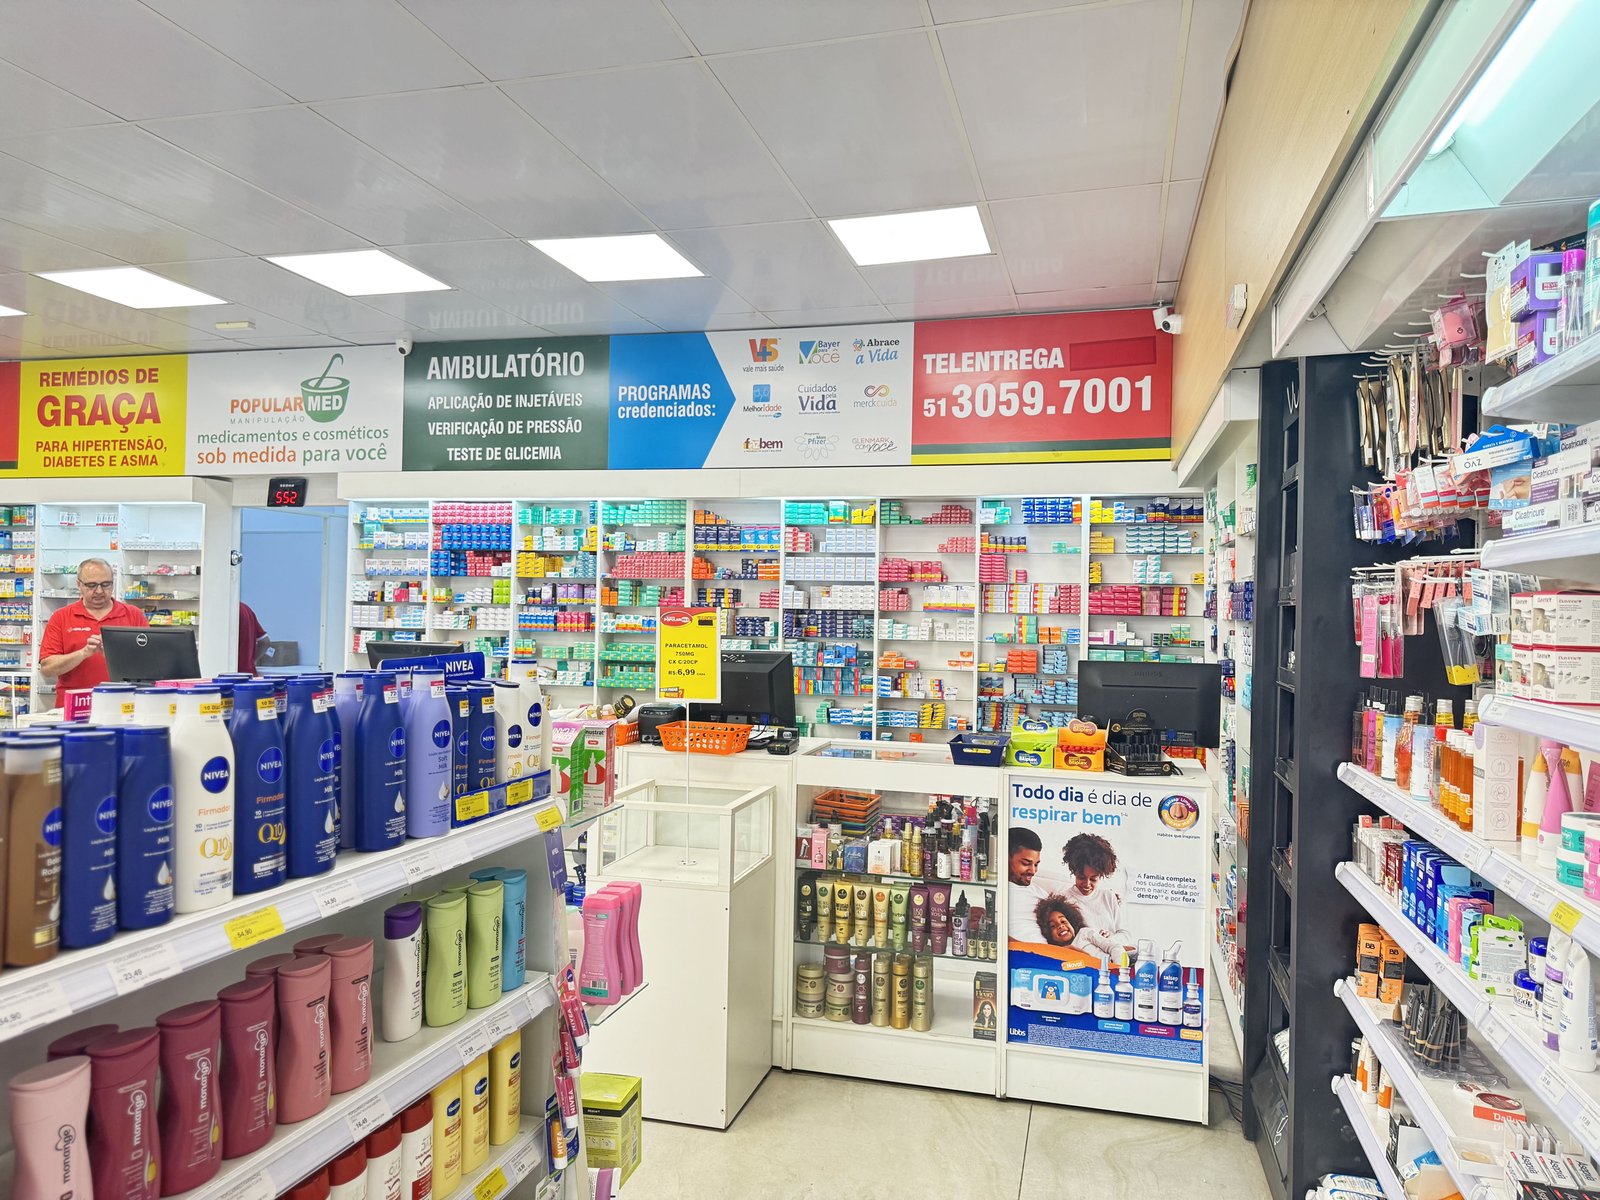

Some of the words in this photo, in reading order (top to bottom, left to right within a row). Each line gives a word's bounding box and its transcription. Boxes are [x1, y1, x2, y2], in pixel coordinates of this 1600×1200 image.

[818, 340, 840, 348] Bayer
[867, 339, 900, 347] Abrace
[426, 347, 585, 379] AMBULATÓRIO
[855, 354, 865, 364] a
[868, 348, 898, 363] Vida
[923, 347, 1065, 374] TELENTREGA
[39, 366, 129, 387] REMÉDIOS
[135, 368, 159, 384] DE
[743, 365, 753, 373] vale
[754, 364, 767, 372] mais
[768, 363, 784, 372] saúde
[618, 383, 711, 402] PROGRAMAS
[798, 384, 837, 393] Cuidados
[923, 398, 947, 417] 51
[951, 375, 1152, 419] 3059.7001
[230, 396, 303, 414] POPULAR
[307, 394, 343, 412] MED
[428, 393, 493, 412] APLICAÇÃO
[497, 395, 511, 408] DE
[515, 391, 583, 408] INJETÁVEIS
[617, 401, 716, 418] credenciados:
[798, 394, 837, 411] Vida
[37, 392, 161, 433] GRAÇA
[230, 415, 306, 425] MANIPULAÇÃO
[197, 429, 297, 444] medicamentos
[302, 432, 310, 441] e
[313, 426, 389, 441] cosméticos
[428, 419, 503, 438] VERIFICAÇÃO
[508, 421, 523, 434] DE
[527, 416, 582, 434] PRESSÃO
[36, 441, 70, 453] PARA
[73, 435, 168, 453] HIPERTENSÃO,
[1560, 438, 1588, 451] Cicatricure
[43, 455, 106, 468] DIABETES
[109, 454, 116, 467] E
[120, 453, 158, 467] ASMA
[197, 447, 227, 464] sob
[233, 445, 297, 463] medida
[302, 449, 341, 466] para
[346, 443, 388, 461] você
[447, 447, 482, 461] TESTE
[486, 447, 502, 460] DE
[505, 446, 561, 460] GLICEMIA
[1532, 466, 1559, 479] Cicatricure
[275, 491, 298, 504] 552
[1514, 507, 1545, 520] Cicatricure
[445, 660, 474, 673] NIVEA
[434, 730, 450, 738] NIVEA
[204, 769, 229, 781] NIVEA
[261, 761, 282, 771] NIVEA
[1012, 784, 1054, 800] Todo
[1058, 786, 1084, 803] dia
[1088, 789, 1098, 804] é
[1102, 790, 1127, 806] dia
[1131, 791, 1152, 808] de
[1012, 806, 1077, 825] respirar
[1082, 808, 1121, 826] bem
[1148, 880, 1175, 888] cuidados
[1166, 875, 1196, 883] completa
[566, 1008, 577, 1031] NIVEA
[1009, 1027, 1026, 1036] Libbs
[258, 1033, 269, 1078] monange
[564, 1041, 572, 1064] NIVEA
[199, 1060, 211, 1109] monange
[568, 1089, 577, 1115] NIVEA
[133, 1093, 147, 1146] monange
[557, 1129, 565, 1156] NIVEA
[62, 1128, 76, 1184] monange
